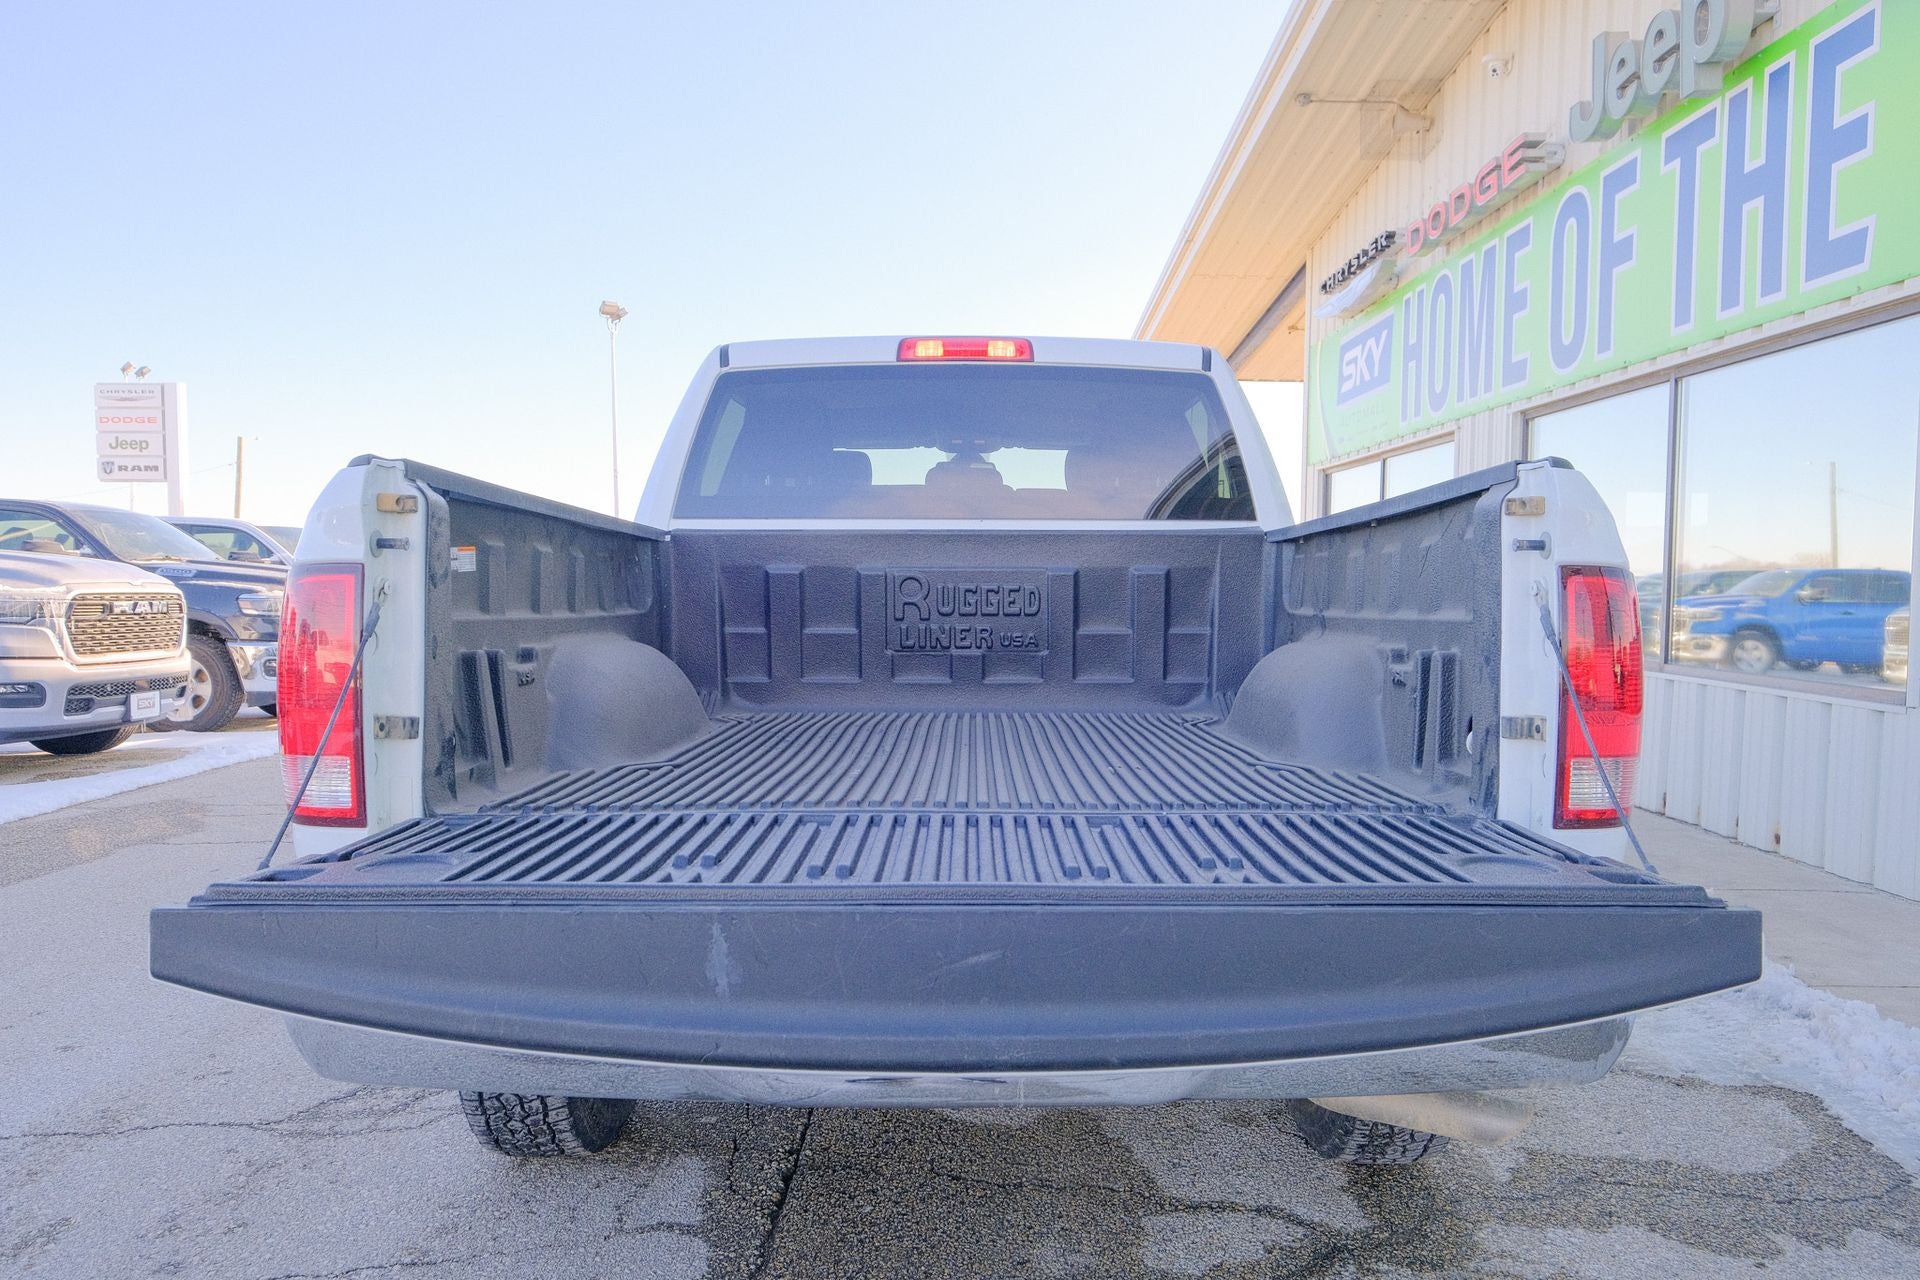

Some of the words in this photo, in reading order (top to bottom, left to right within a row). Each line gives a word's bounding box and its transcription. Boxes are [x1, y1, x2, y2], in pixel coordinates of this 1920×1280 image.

[1569, 0, 1726, 143] Jeep
[1400, 219, 1533, 426] HOME
[1549, 148, 1641, 376] OF
[1661, 0, 1882, 337] THE
[1406, 133, 1530, 256] DODGE
[1319, 230, 1394, 294] CHRYSLER
[1340, 328, 1389, 394] SKY
[99, 416, 158, 424] DODGE
[108, 436, 149, 452] Jeep
[113, 601, 168, 614] RAM
[893, 574, 1042, 622] RUGGED
[900, 623, 994, 649] LINER
[1000, 631, 1040, 649] USA
